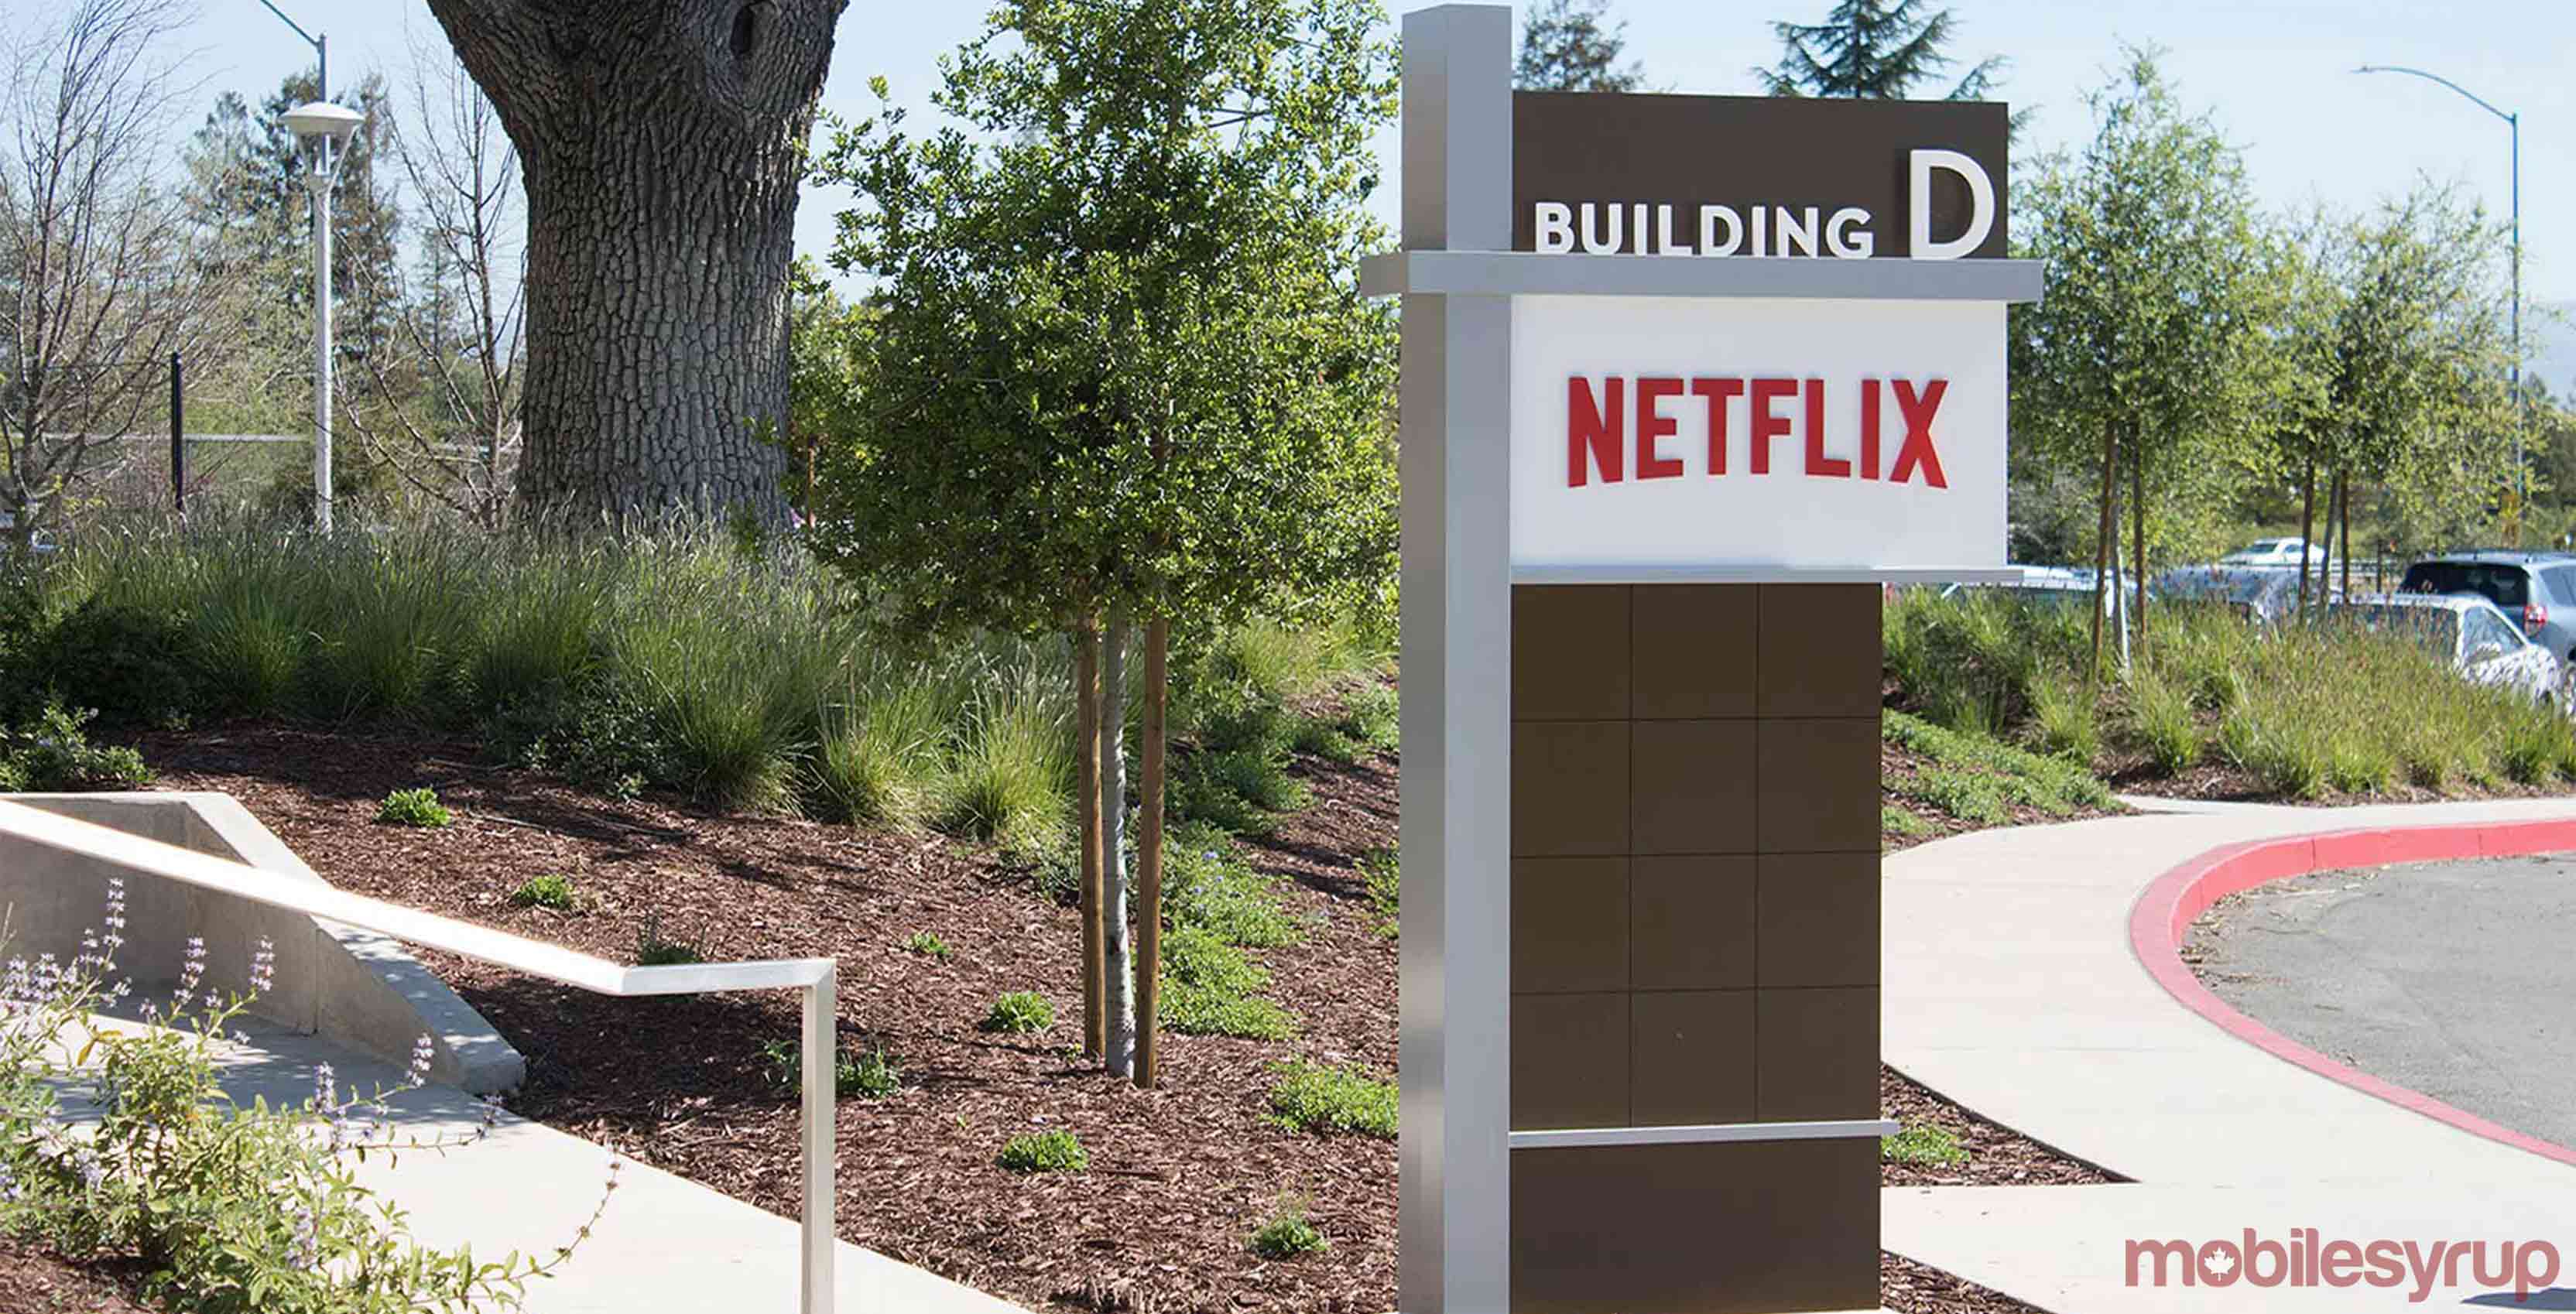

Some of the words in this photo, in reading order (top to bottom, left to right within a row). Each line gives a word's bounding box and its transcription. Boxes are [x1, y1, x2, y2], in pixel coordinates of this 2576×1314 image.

[1534, 201, 1874, 258] BUILDING
[1910, 149, 1995, 260] D
[1567, 376, 1949, 489] NETFLIX
